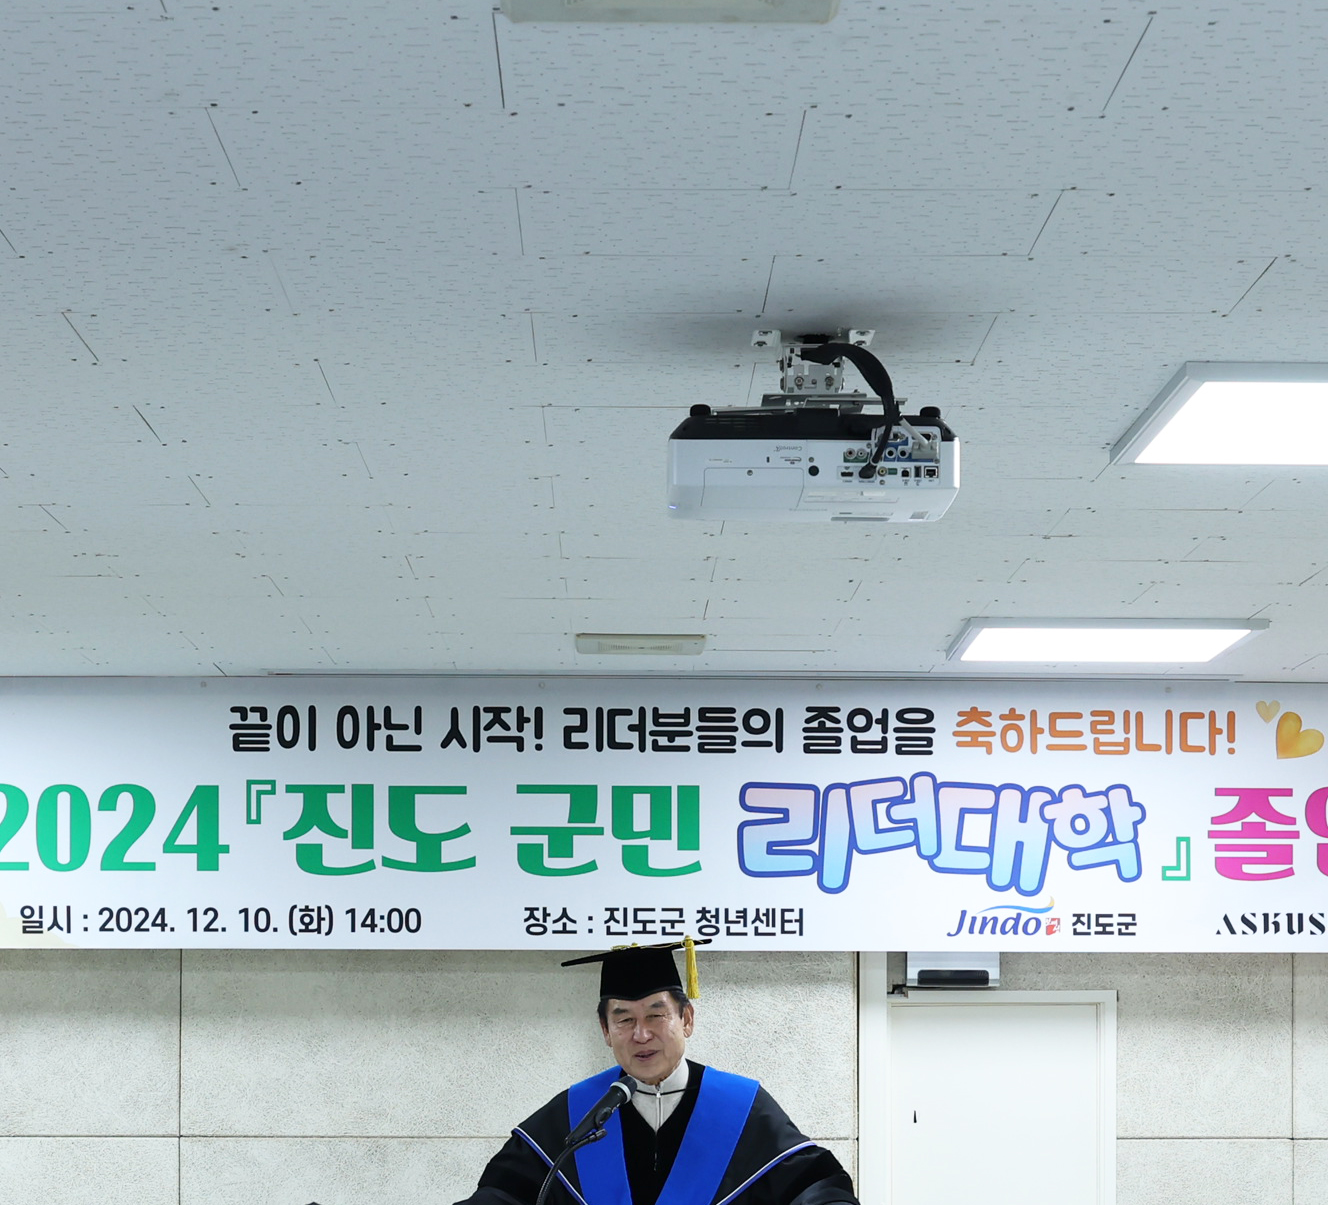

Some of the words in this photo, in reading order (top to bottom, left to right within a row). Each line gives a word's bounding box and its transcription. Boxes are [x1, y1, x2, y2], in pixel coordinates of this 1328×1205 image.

[229, 705, 316, 752] 끝이
[337, 705, 422, 751] 아닌
[441, 706, 543, 753] 시작!
[563, 706, 783, 753] 리더분들의
[802, 706, 936, 755] 졸업을
[952, 705, 1237, 756] 축하드립니다!
[510, 784, 702, 877] 군민
[20, 906, 71, 934] 일시
[99, 907, 174, 932] 2024.
[187, 907, 226, 932] 12.
[239, 907, 278, 932] 10.
[289, 905, 333, 936] (화)
[346, 908, 421, 933] 14:00
[524, 907, 577, 935] 장소
[604, 907, 685, 936] 진도군
[696, 907, 803, 936] 청년센터
[946, 909, 1042, 937] Jindo
[1072, 913, 1137, 936] 진도군
